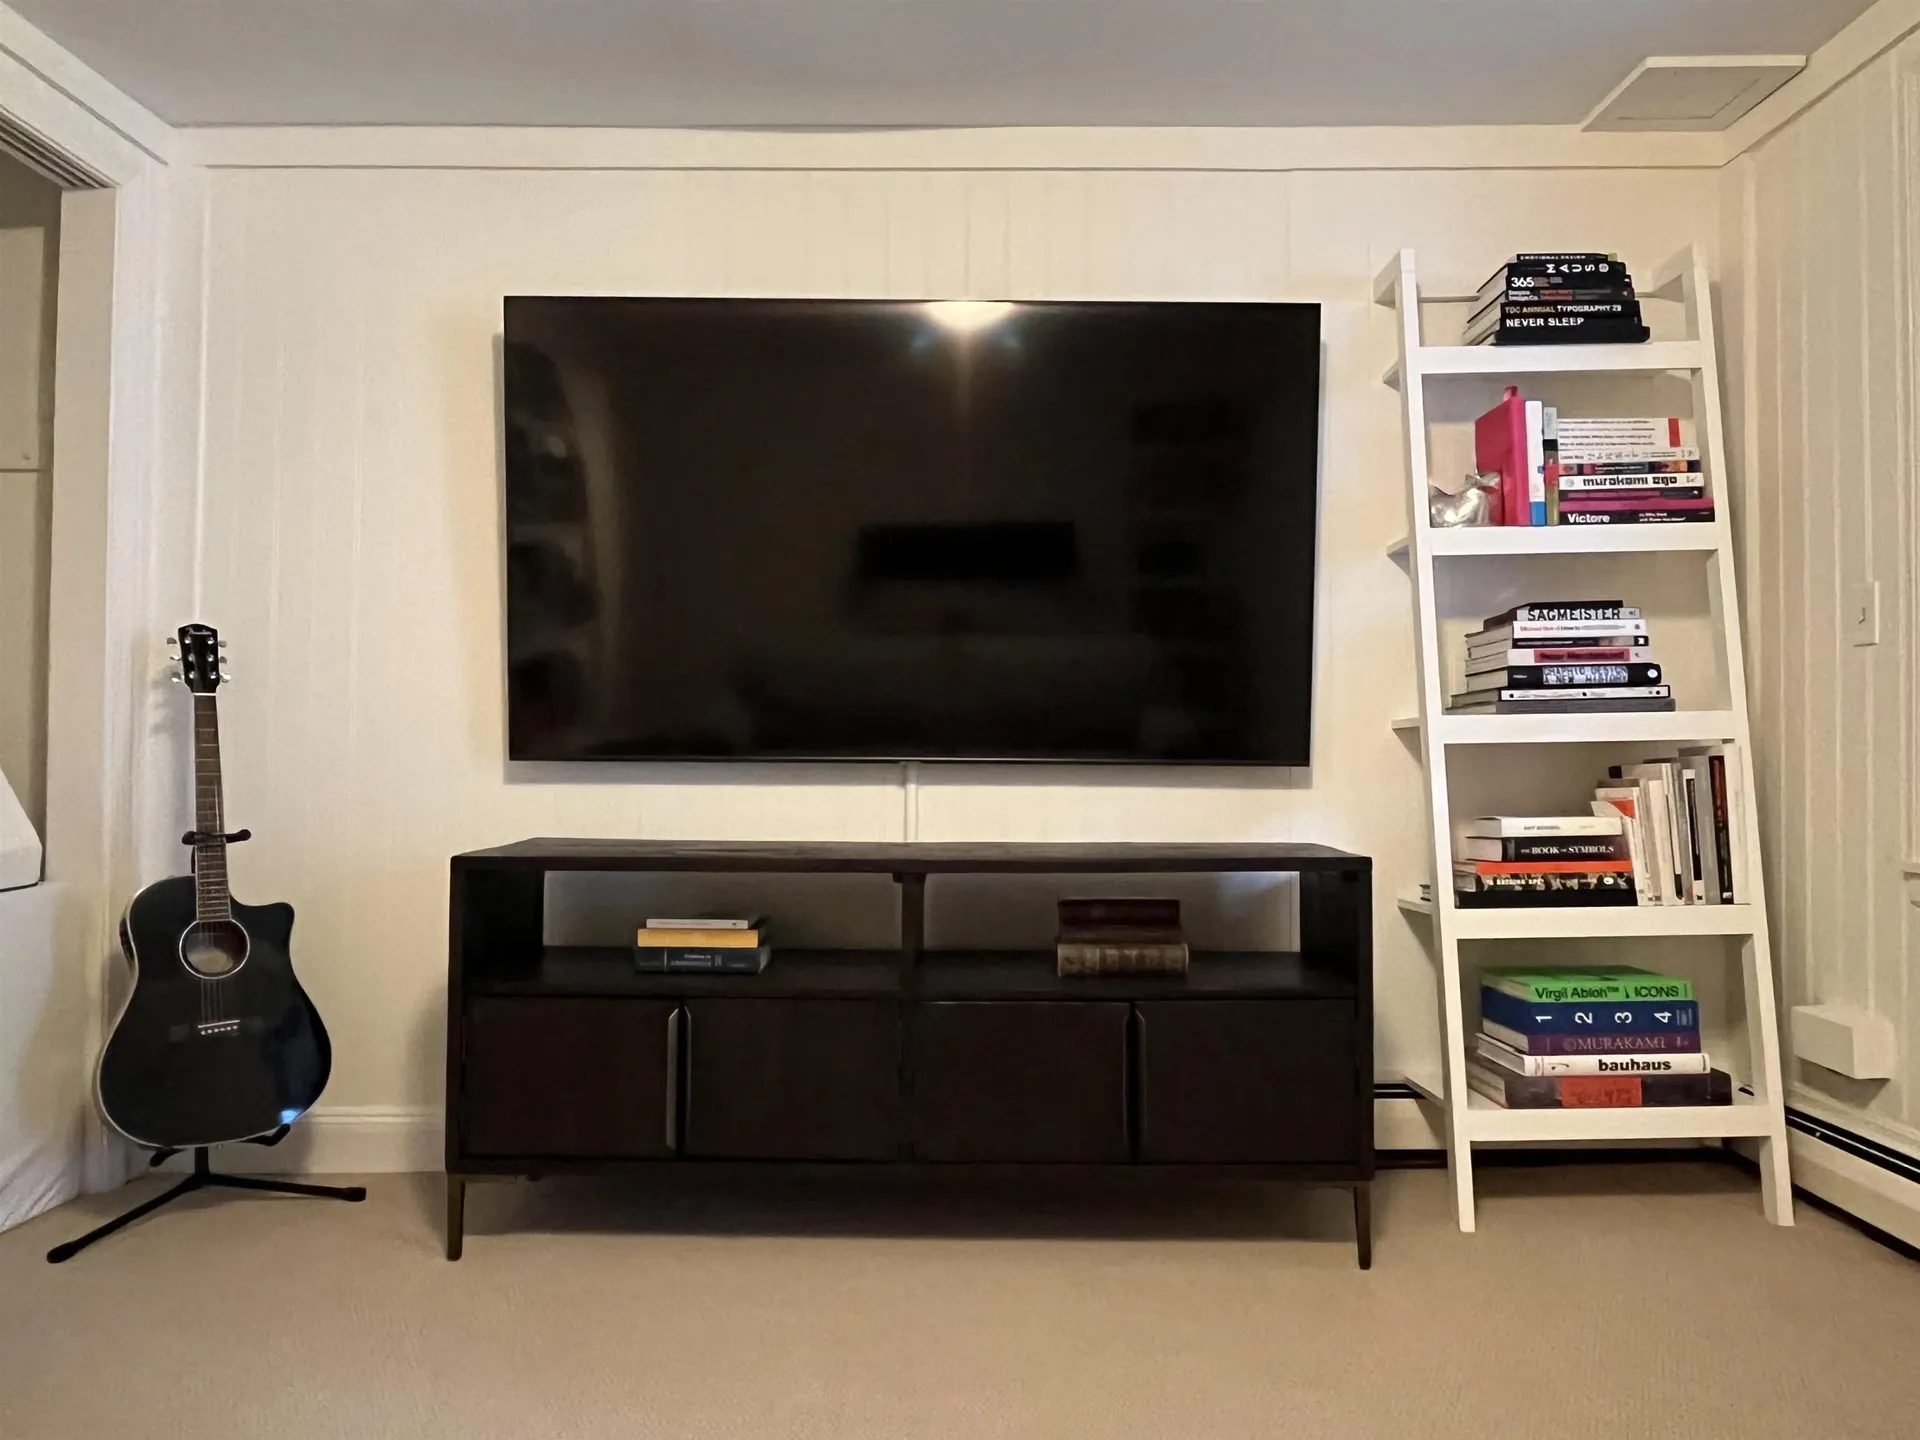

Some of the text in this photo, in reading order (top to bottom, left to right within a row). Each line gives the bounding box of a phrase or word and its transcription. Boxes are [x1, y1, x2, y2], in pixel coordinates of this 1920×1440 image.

[1545, 263, 1596, 274] MAUS
[1511, 276, 1535, 288] 365
[1556, 304, 1611, 313] TYPOGRAPHY
[1505, 316, 1585, 328] NEVER SLEEP
[1583, 476, 1678, 487] murakami ego
[1567, 513, 1611, 524] Victore
[1527, 608, 1621, 621] SAGMEISTER
[1531, 846, 1560, 855] BOOK
[1568, 845, 1615, 854] SYMBOLS
[1535, 986, 1568, 1001] Virgil
[1634, 985, 1679, 998] ICONS
[1535, 1014, 1553, 1024] 1
[1574, 1011, 1594, 1025] 2
[1614, 1011, 1633, 1024] 3
[1653, 1010, 1673, 1024] 4
[1598, 1058, 1672, 1072] bauhaus
